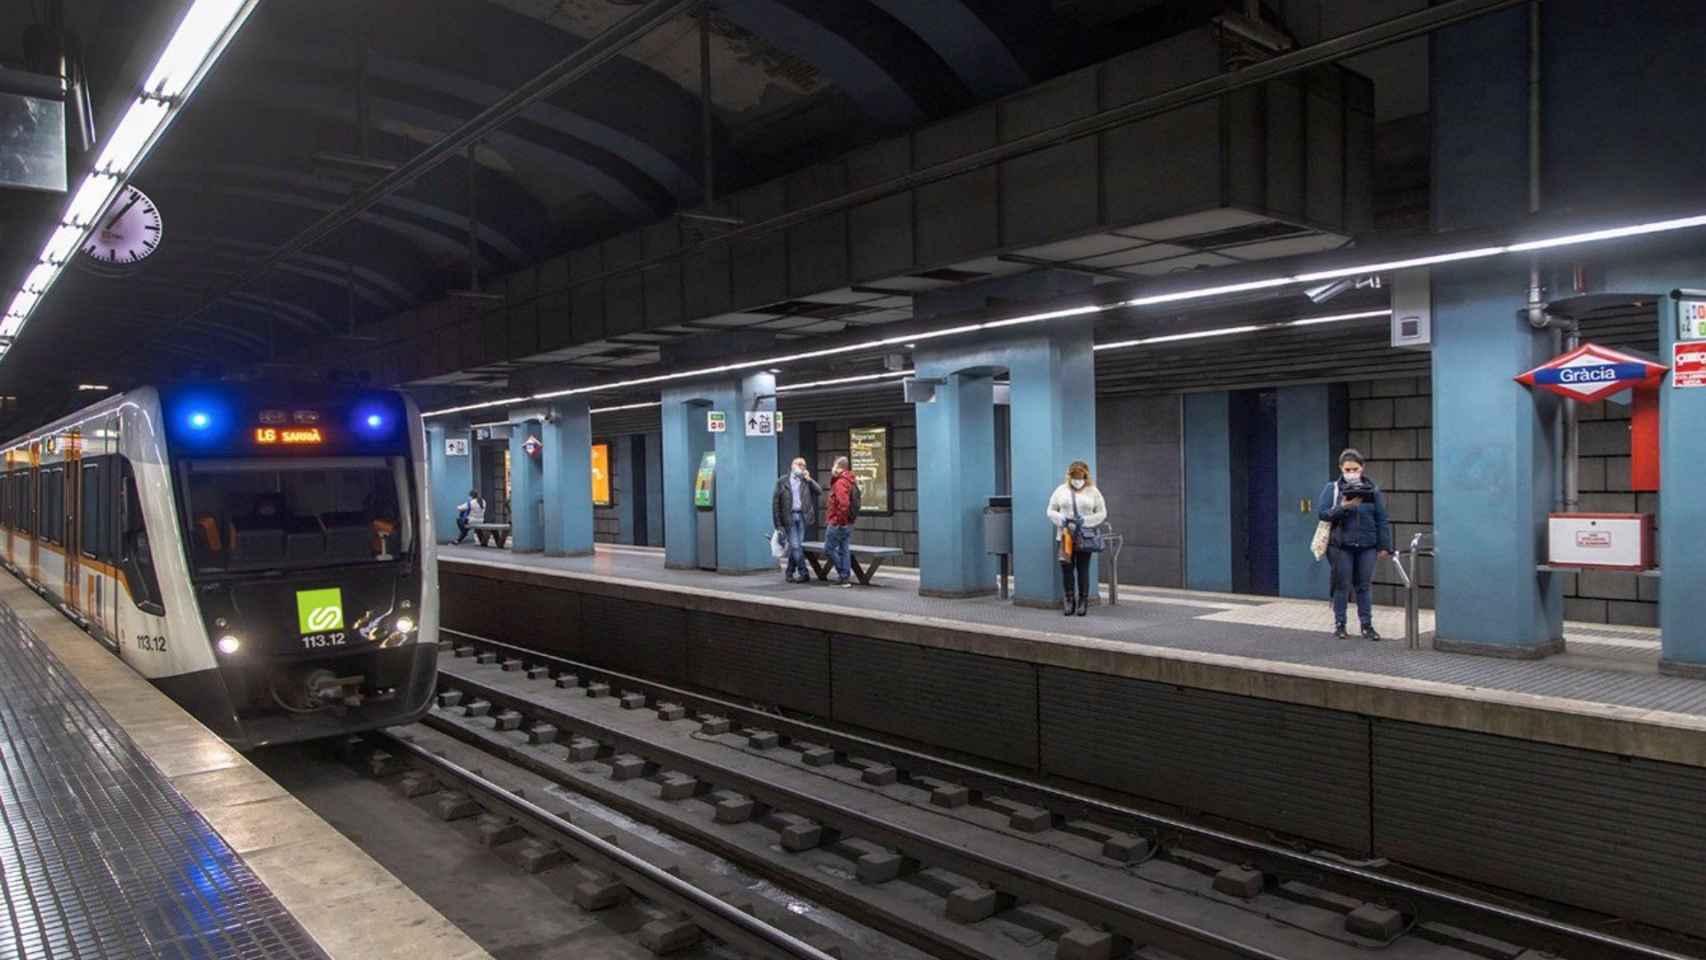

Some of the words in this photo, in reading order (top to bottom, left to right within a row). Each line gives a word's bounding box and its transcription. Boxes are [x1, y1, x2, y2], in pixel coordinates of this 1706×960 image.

[1560, 366, 1616, 382] Gràcia
[256, 428, 276, 442] L6
[281, 428, 321, 442] SARRÀ
[136, 634, 167, 652] 113.12
[302, 632, 346, 648] 113.12
